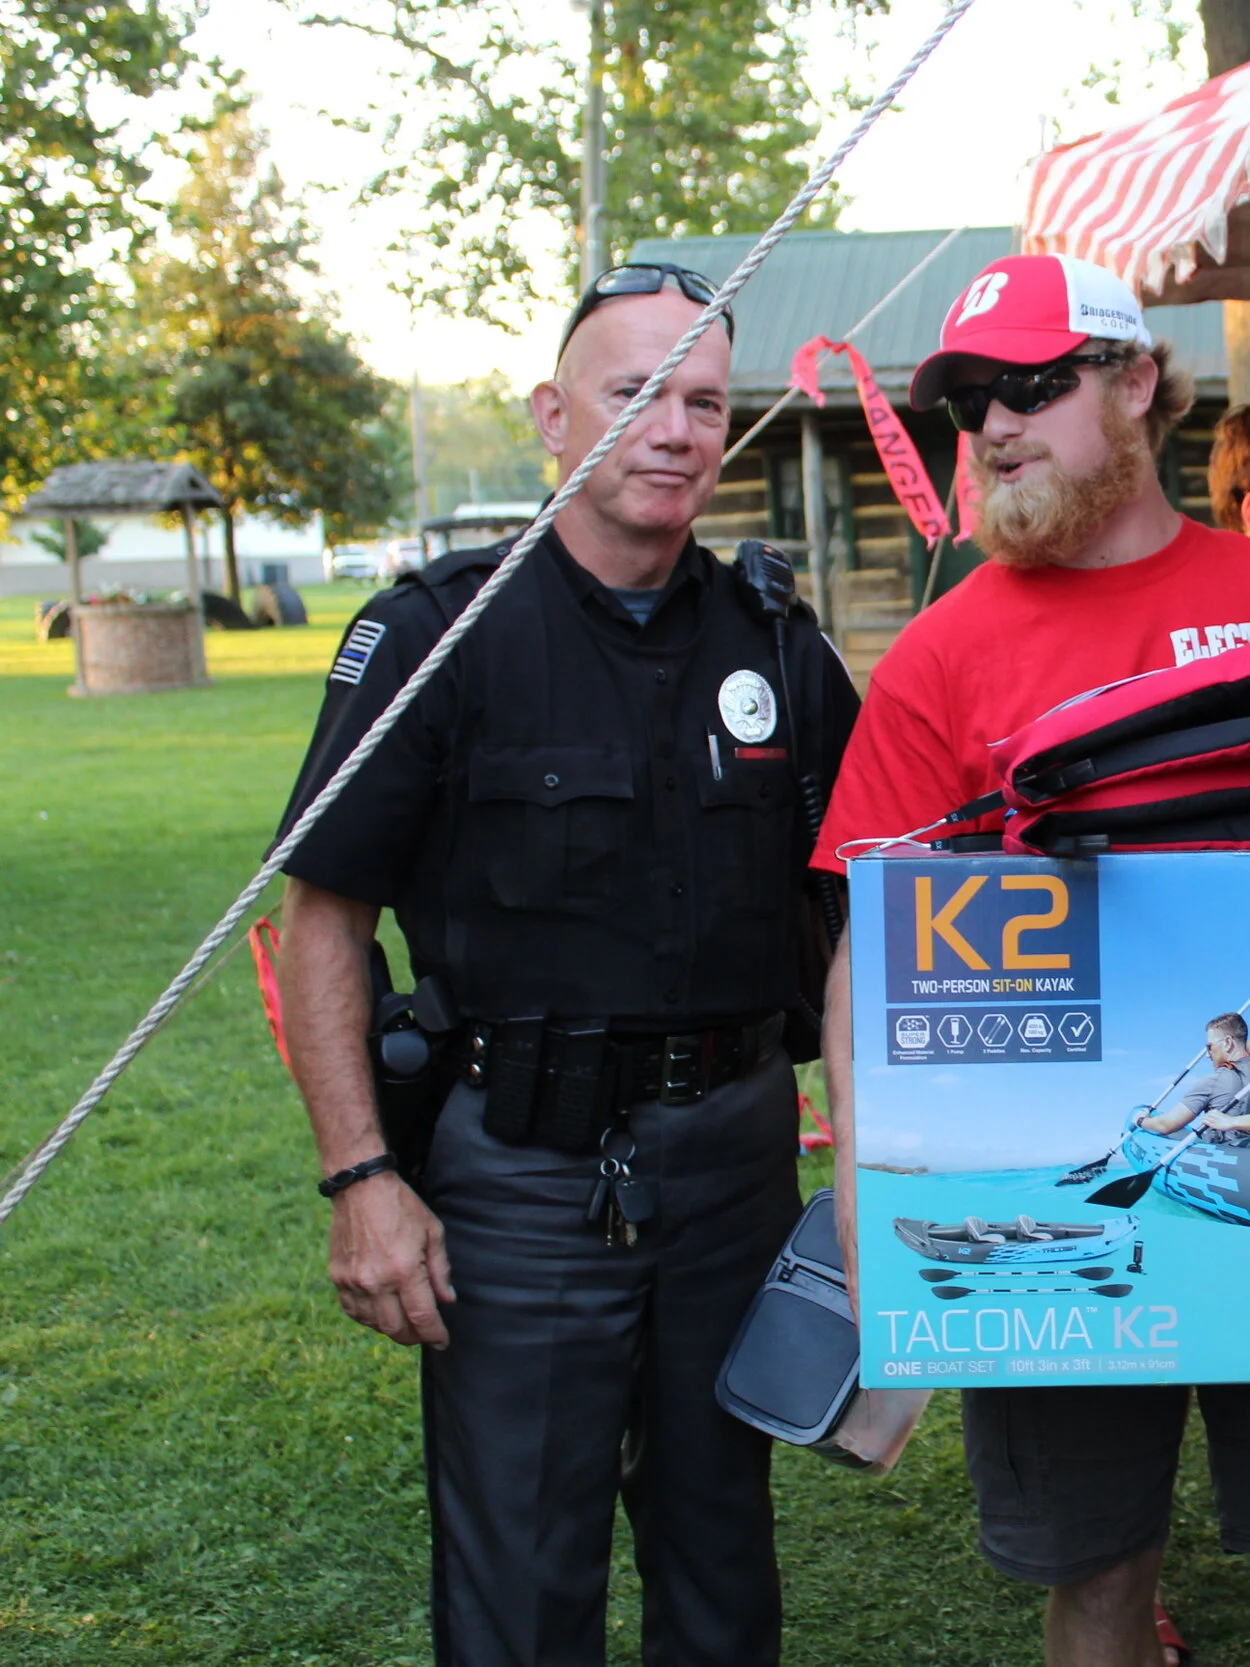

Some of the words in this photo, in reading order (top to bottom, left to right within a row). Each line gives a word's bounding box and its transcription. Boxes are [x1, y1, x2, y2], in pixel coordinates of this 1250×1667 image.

[914, 874, 1071, 972] K2
[911, 979, 990, 995] TWO-PERSON
[991, 978, 1033, 993] SIT-ON
[1035, 977, 1075, 992] KAYAK
[877, 1306, 1093, 1354] TACOMA
[1113, 1305, 1180, 1349] K2
[884, 1361, 922, 1376] ONE
[927, 1360, 966, 1375] BOAT
[968, 1359, 996, 1373] SET
[1010, 1359, 1036, 1372] 10ft
[1037, 1359, 1058, 1371] 3in
[1072, 1358, 1091, 1371] 3ft
